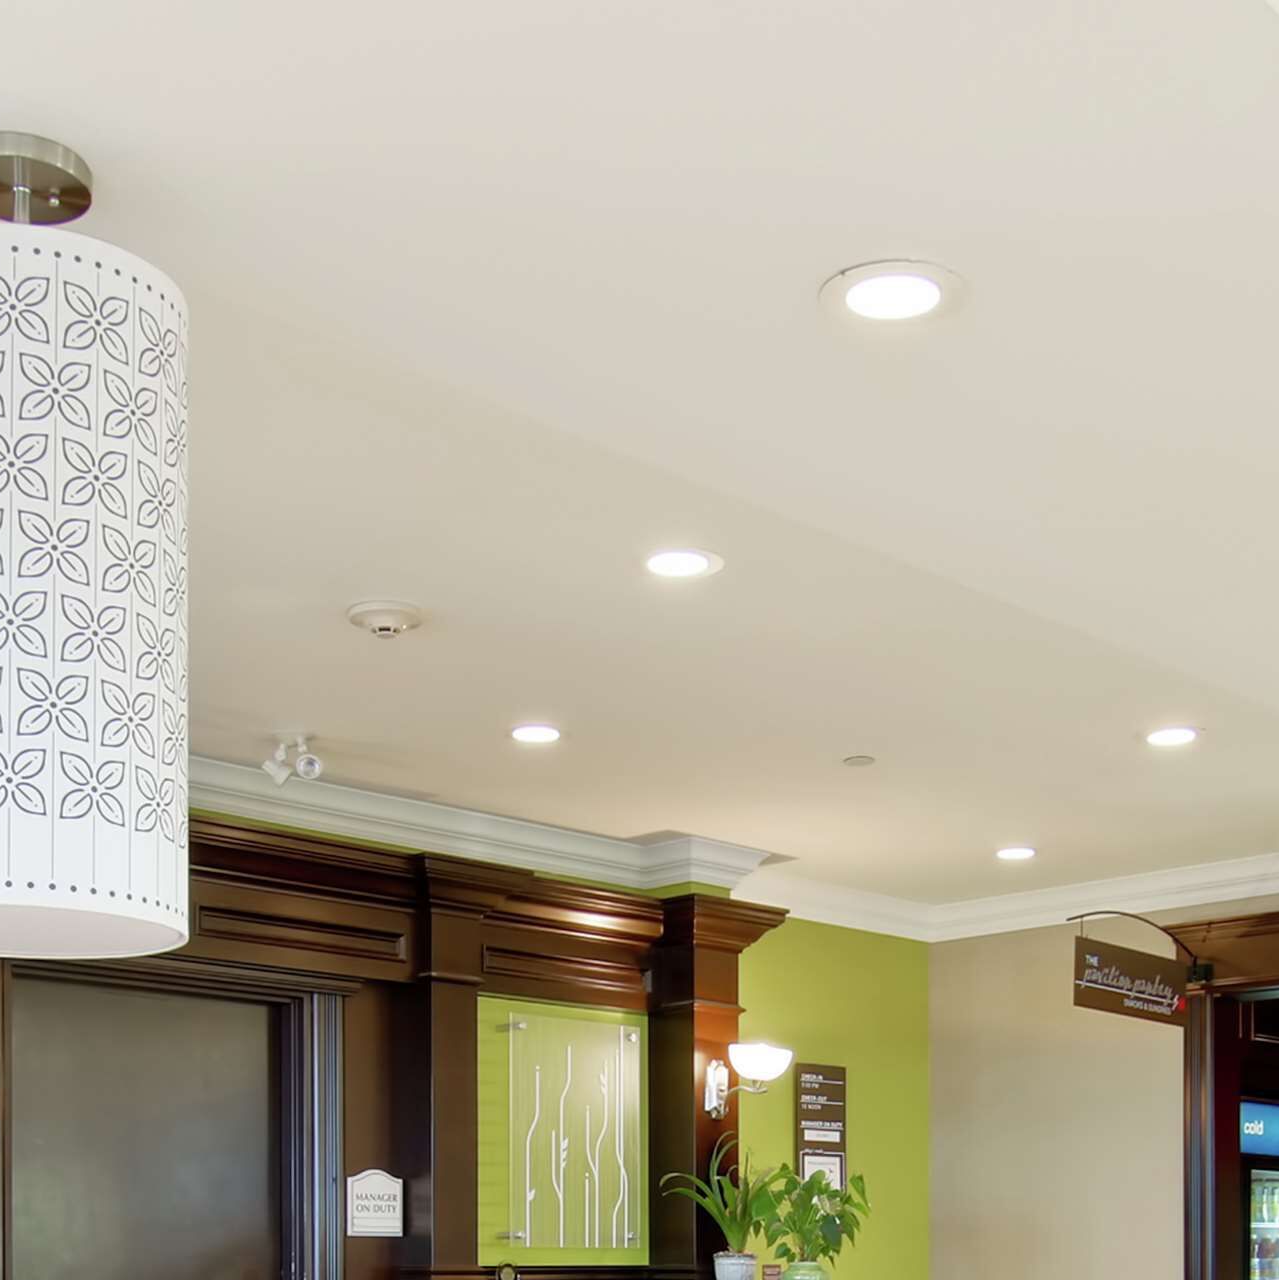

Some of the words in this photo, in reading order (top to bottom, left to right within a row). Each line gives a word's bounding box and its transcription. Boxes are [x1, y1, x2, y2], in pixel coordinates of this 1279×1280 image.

[1084, 953, 1099, 967] THE
[1244, 1119, 1264, 1136] cold
[355, 1192, 399, 1202] MANAGER
[355, 1203, 370, 1213] ON
[372, 1204, 398, 1214] DUTY
